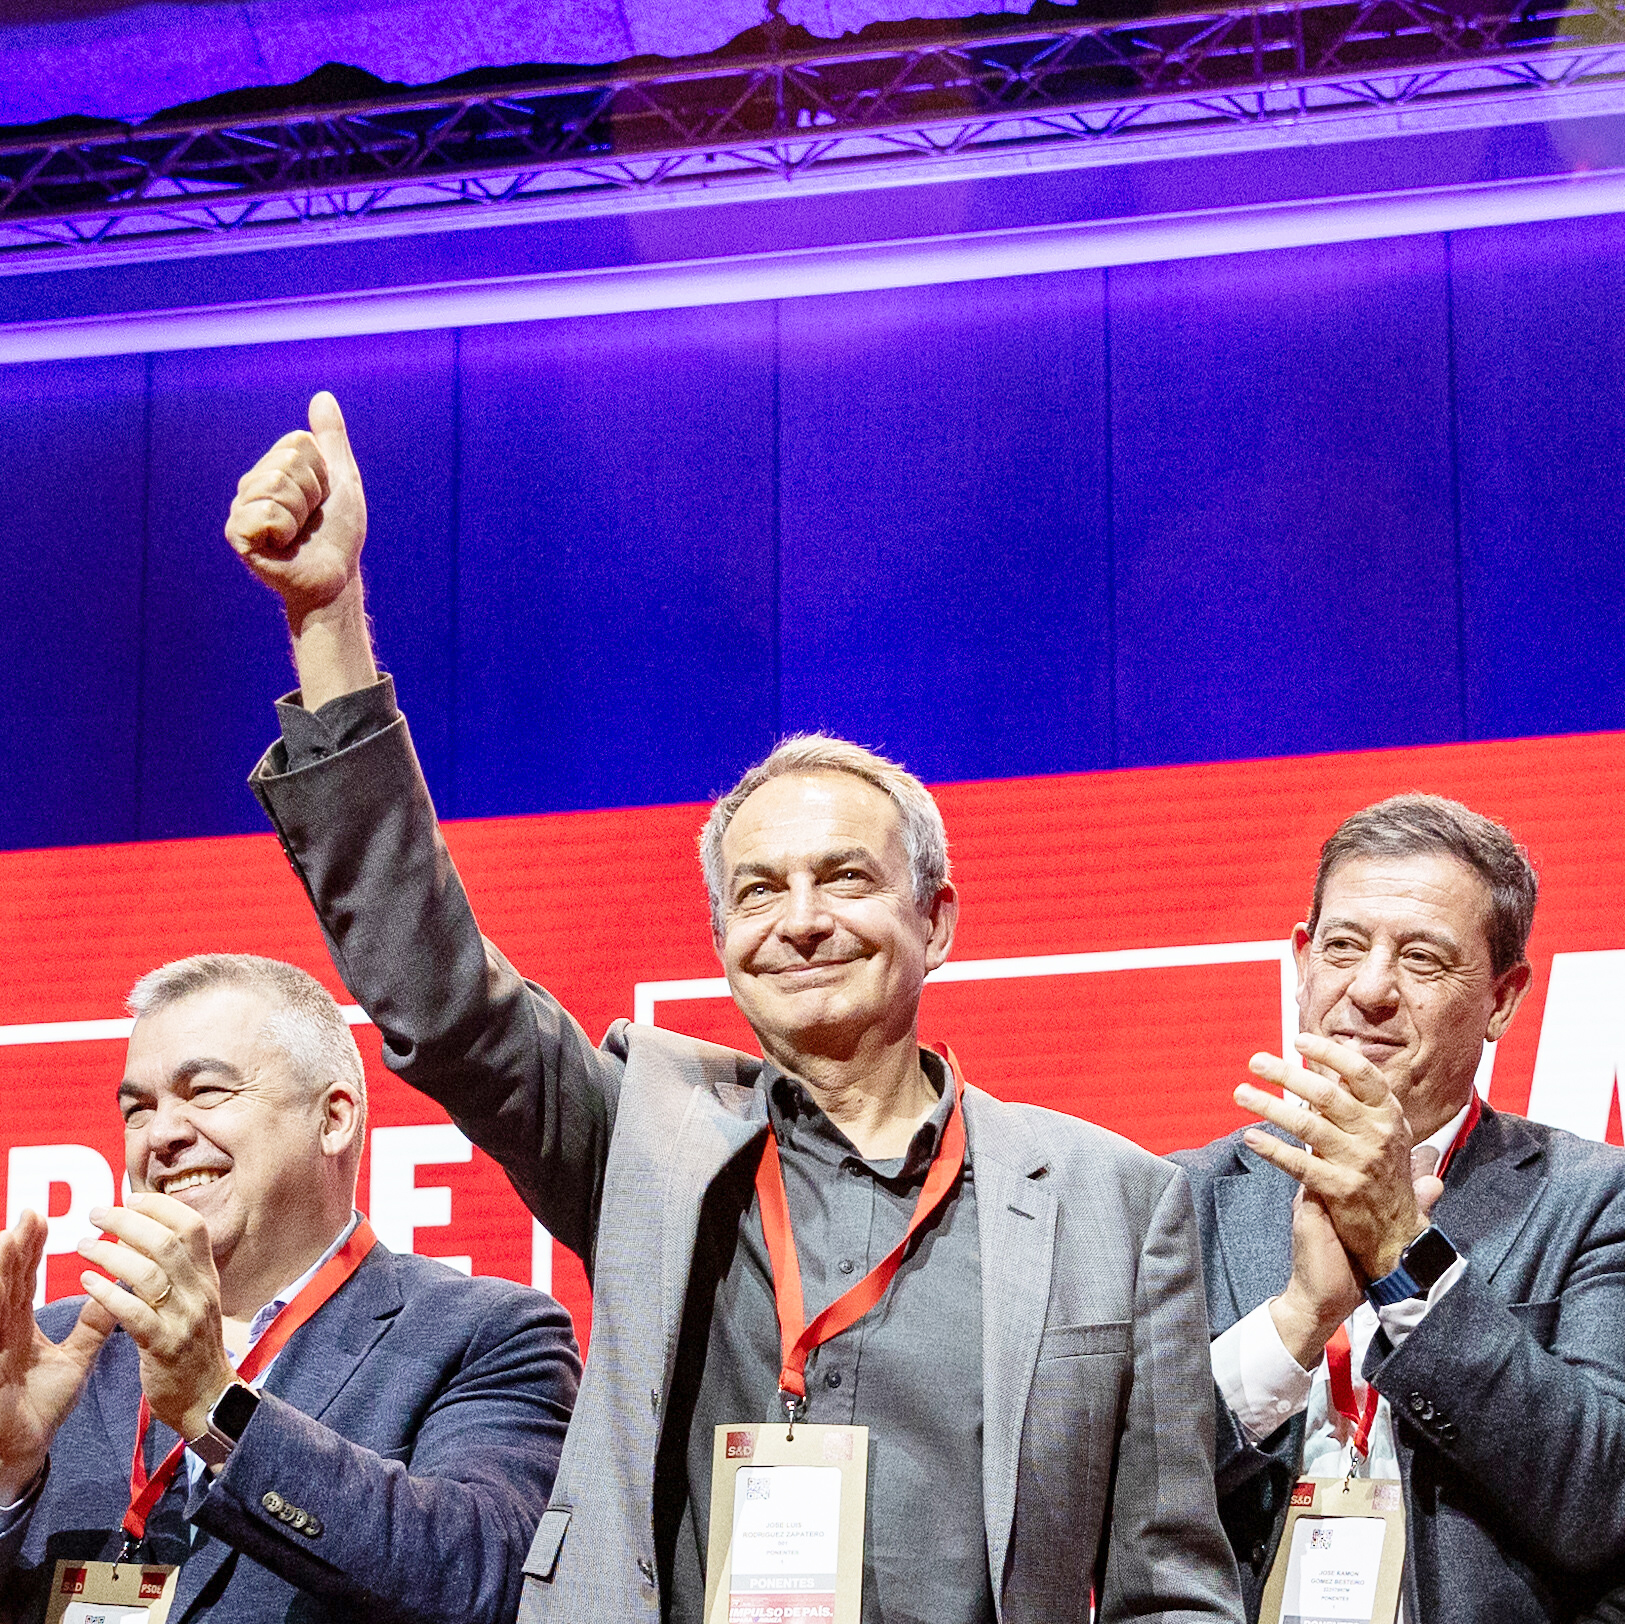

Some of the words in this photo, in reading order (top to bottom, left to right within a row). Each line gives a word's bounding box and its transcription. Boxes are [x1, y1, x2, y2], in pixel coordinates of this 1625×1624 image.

[5, 1123, 473, 1306] PE
[727, 1445, 752, 1456] S&D
[1290, 1494, 1311, 1505] S&D
[140, 1583, 163, 1594] PSOE
[749, 1577, 815, 1589] PONENTES
[729, 1607, 784, 1618] IMPULSO
[784, 1607, 801, 1617] DE
